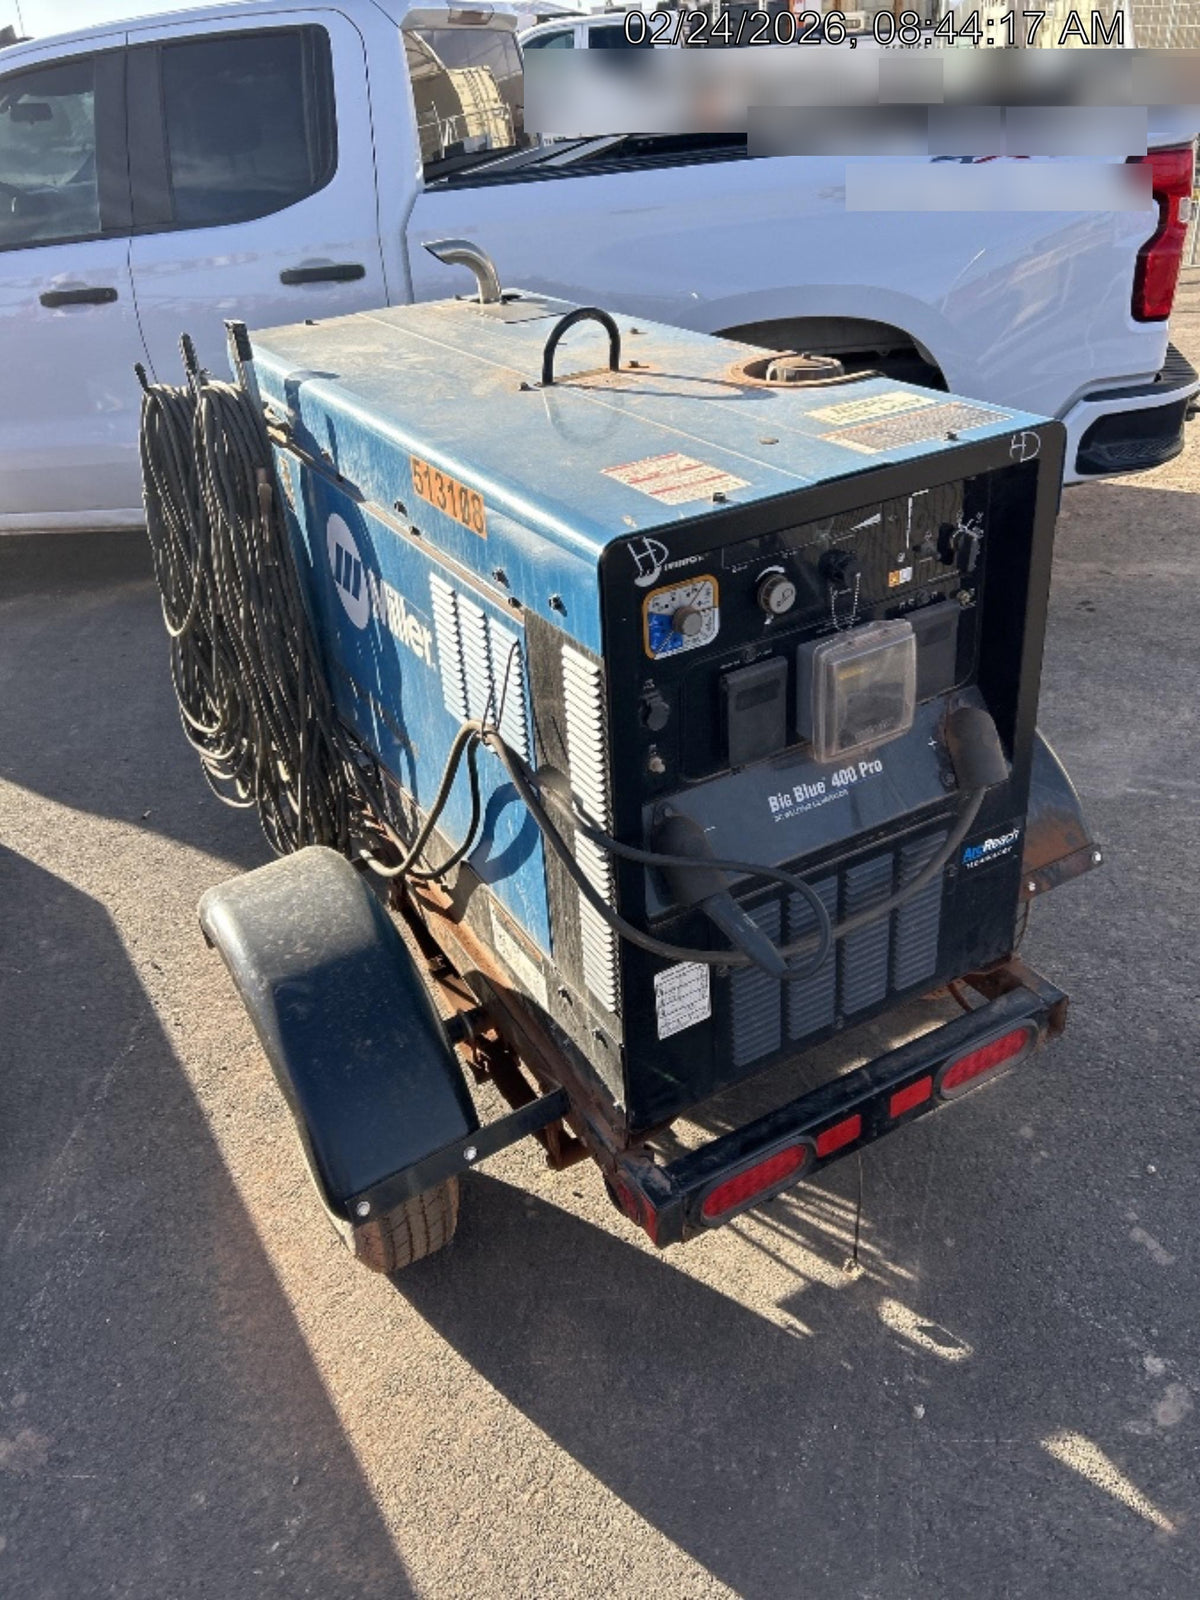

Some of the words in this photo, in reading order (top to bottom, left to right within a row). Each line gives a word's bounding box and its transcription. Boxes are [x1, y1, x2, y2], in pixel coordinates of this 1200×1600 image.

[412, 457, 485, 535] 513108
[767, 792, 794, 813] Big
[792, 780, 827, 803] Blue
[831, 765, 858, 788] 400
[858, 759, 884, 778] Pro
